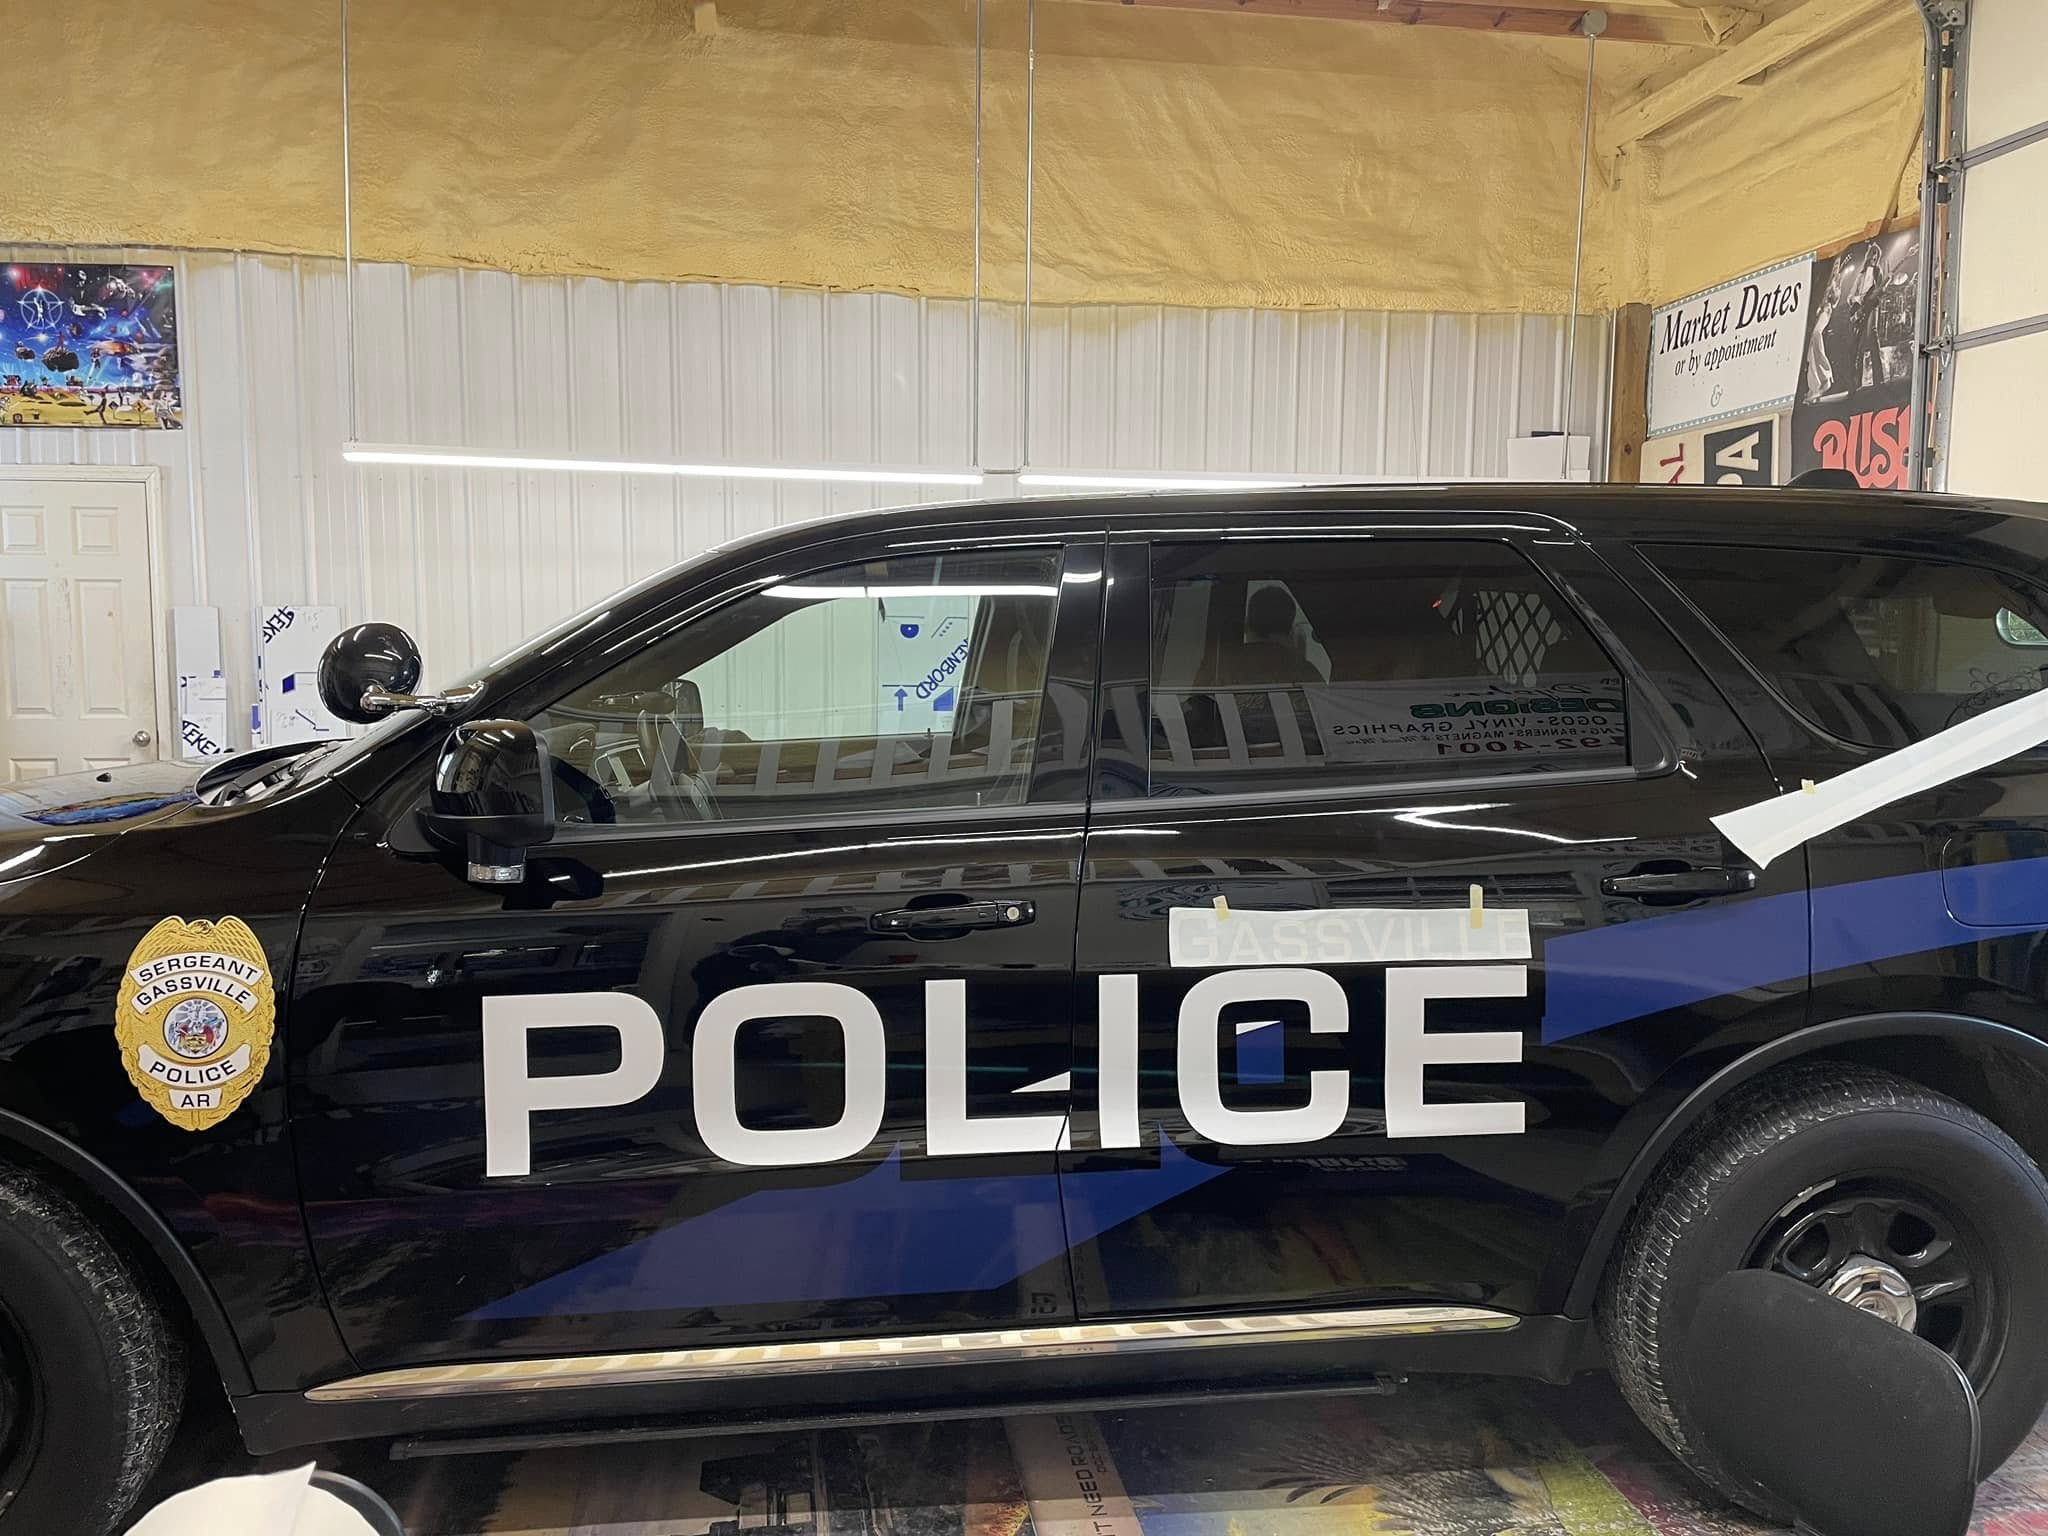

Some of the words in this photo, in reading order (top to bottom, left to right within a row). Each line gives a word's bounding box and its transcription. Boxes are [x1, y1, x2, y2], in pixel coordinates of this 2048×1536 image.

[1660, 298, 1731, 355] Market
[1735, 282, 1802, 330] Dates
[1675, 359, 1686, 376] or
[1688, 349, 1701, 376] by
[1704, 328, 1777, 372] appointment
[139, 955, 258, 982] SERGEANT
[137, 976, 251, 1006] GASSVILLE
[149, 1060, 237, 1084] POLICE
[482, 965, 1528, 1178] POLICE
[181, 1094, 210, 1108] AR
[1075, 1469, 1108, 1517] NEED
